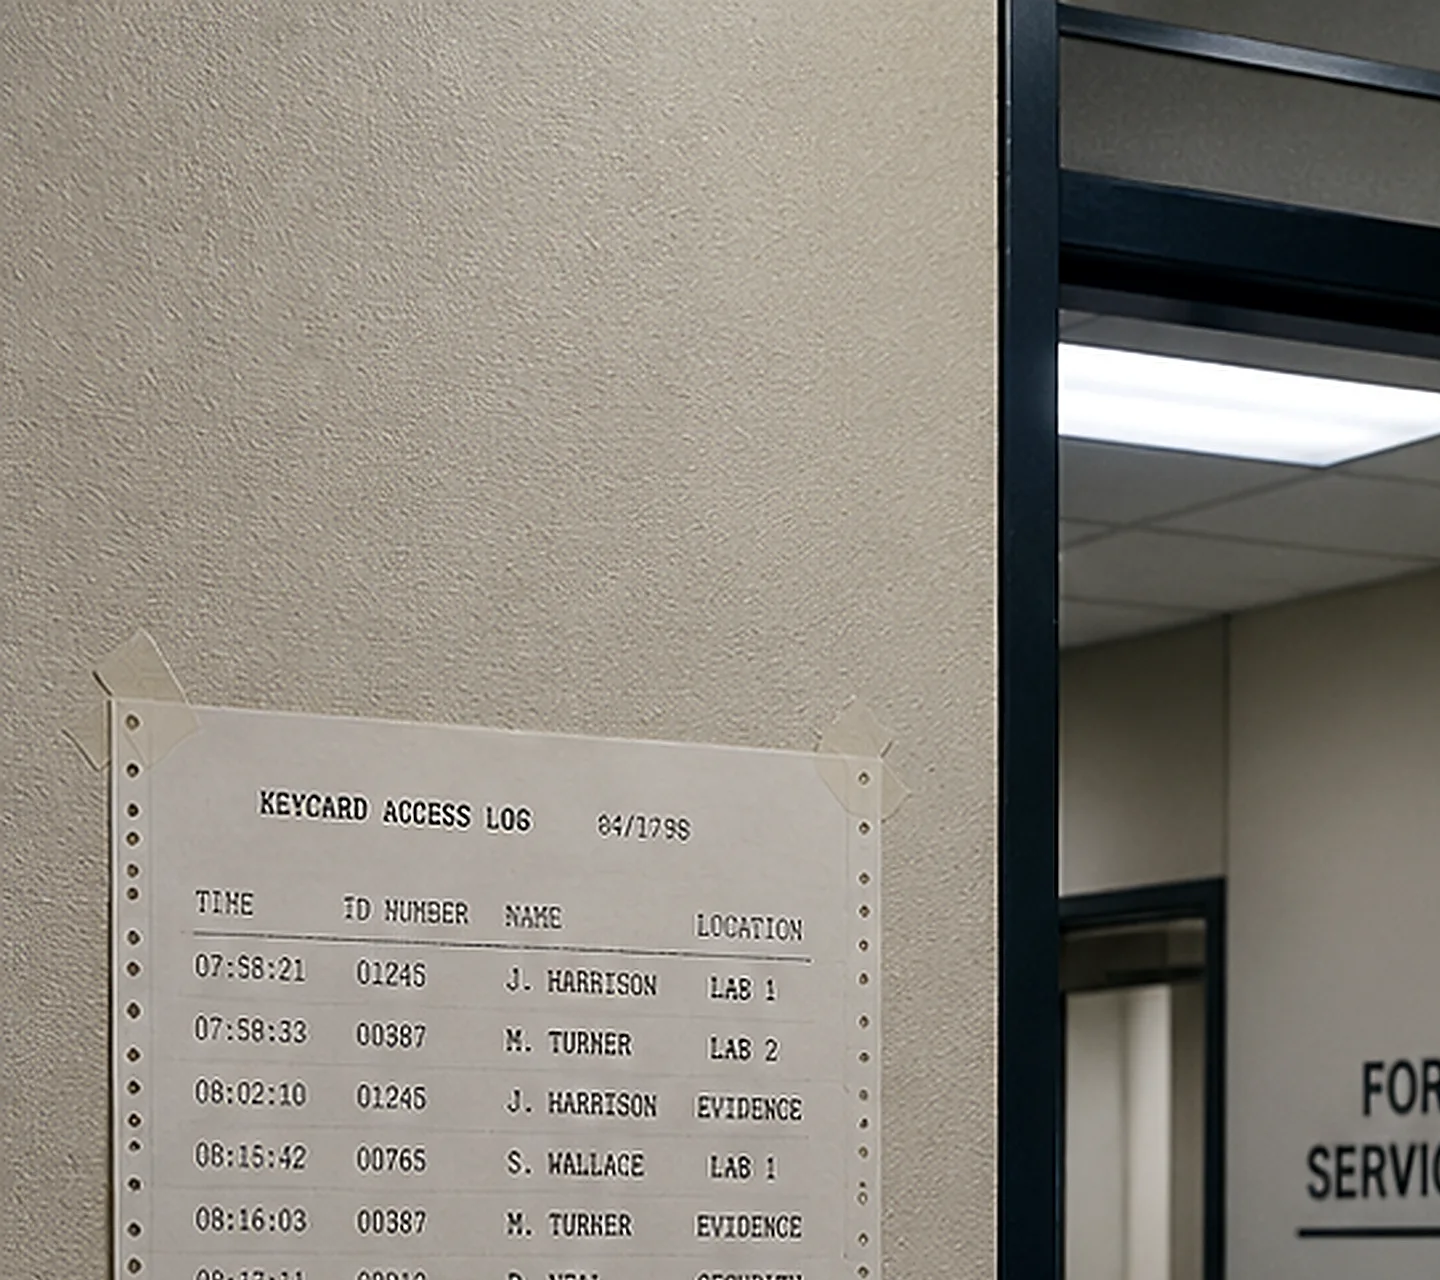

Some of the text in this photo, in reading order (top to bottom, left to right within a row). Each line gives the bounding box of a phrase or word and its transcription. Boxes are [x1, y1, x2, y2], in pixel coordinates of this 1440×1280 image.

[260, 789, 368, 821] KEYCARD
[382, 799, 472, 831] ACCESS
[486, 806, 532, 832] LOG
[195, 889, 802, 942] TIME ID NUMBER NAME LOCATION
[195, 953, 776, 1002] 07:58:21 01245 J. HARRISON LAB 1
[194, 1015, 778, 1062] 07:58:33 00387 M. TURNER LAB 2
[195, 1078, 803, 1122] 08:02:10 01245 J. HARRISON EVIDENCE
[195, 1141, 776, 1180] 08:15:42 00765 S. WALLACE LAB 1
[195, 1205, 803, 1239] 08:16:03 00387 M. TURNER EVIDENCE
